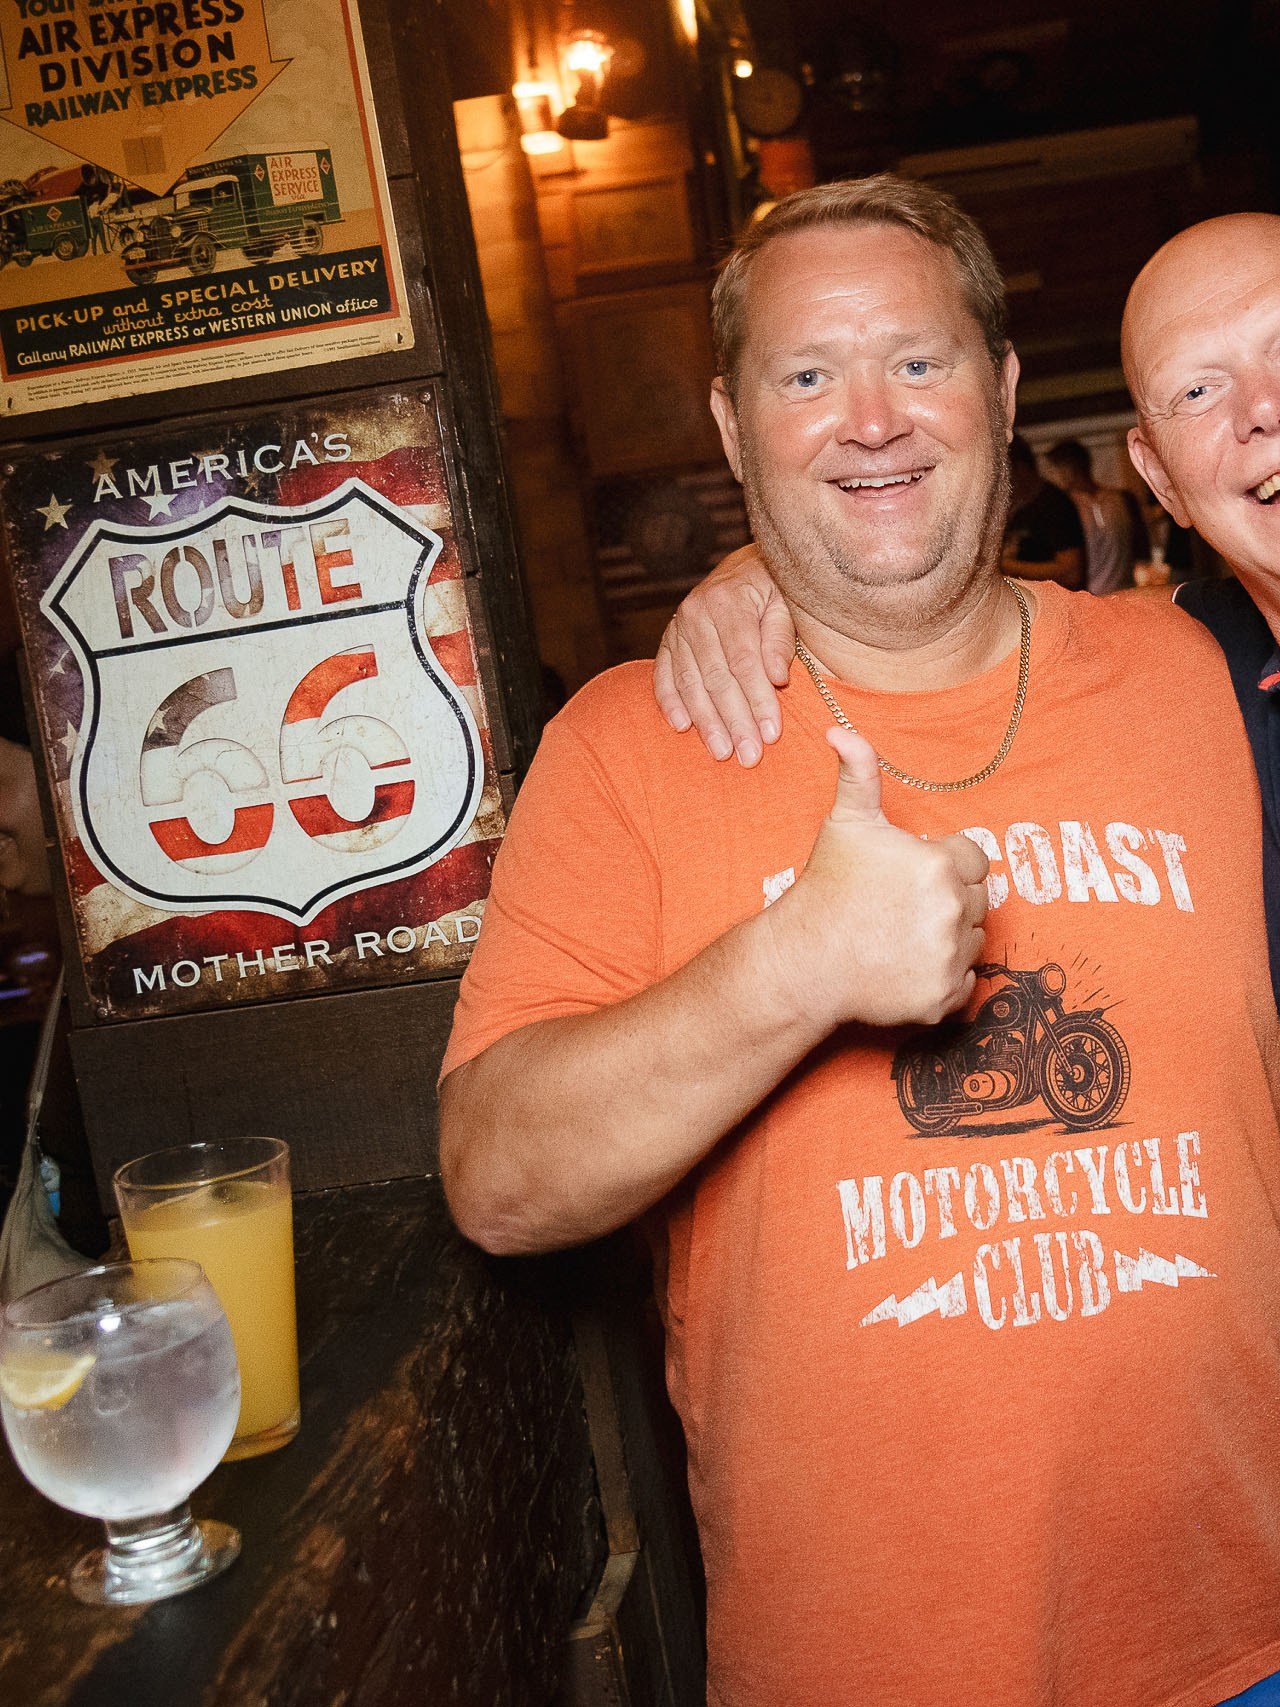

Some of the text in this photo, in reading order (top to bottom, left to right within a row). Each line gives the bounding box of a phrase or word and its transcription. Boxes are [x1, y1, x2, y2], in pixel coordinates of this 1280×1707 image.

[18, 0, 245, 60] AIR EXPRESS
[39, 32, 236, 92] DIVISION
[25, 65, 258, 128] RAILWAY EXPRESS
[270, 156, 293, 169] AIR
[271, 167, 317, 181] EXPRESS
[273, 180, 319, 197] SERVICE
[16, 259, 377, 333] PICK-UP and SPECIAL DELIVERY
[102, 294, 273, 335] without extra cost
[17, 297, 379, 367] Call any RAILWAY EXPRESS or WESTERN UNION office
[93, 431, 353, 503] AMERICA'S
[107, 518, 363, 639] ROUTE
[140, 643, 416, 876] 66
[132, 916, 482, 995] MOTHER ROAD
[836, 1131, 1208, 1270] MOTORCYCLE
[973, 1230, 1112, 1331] CLUB
